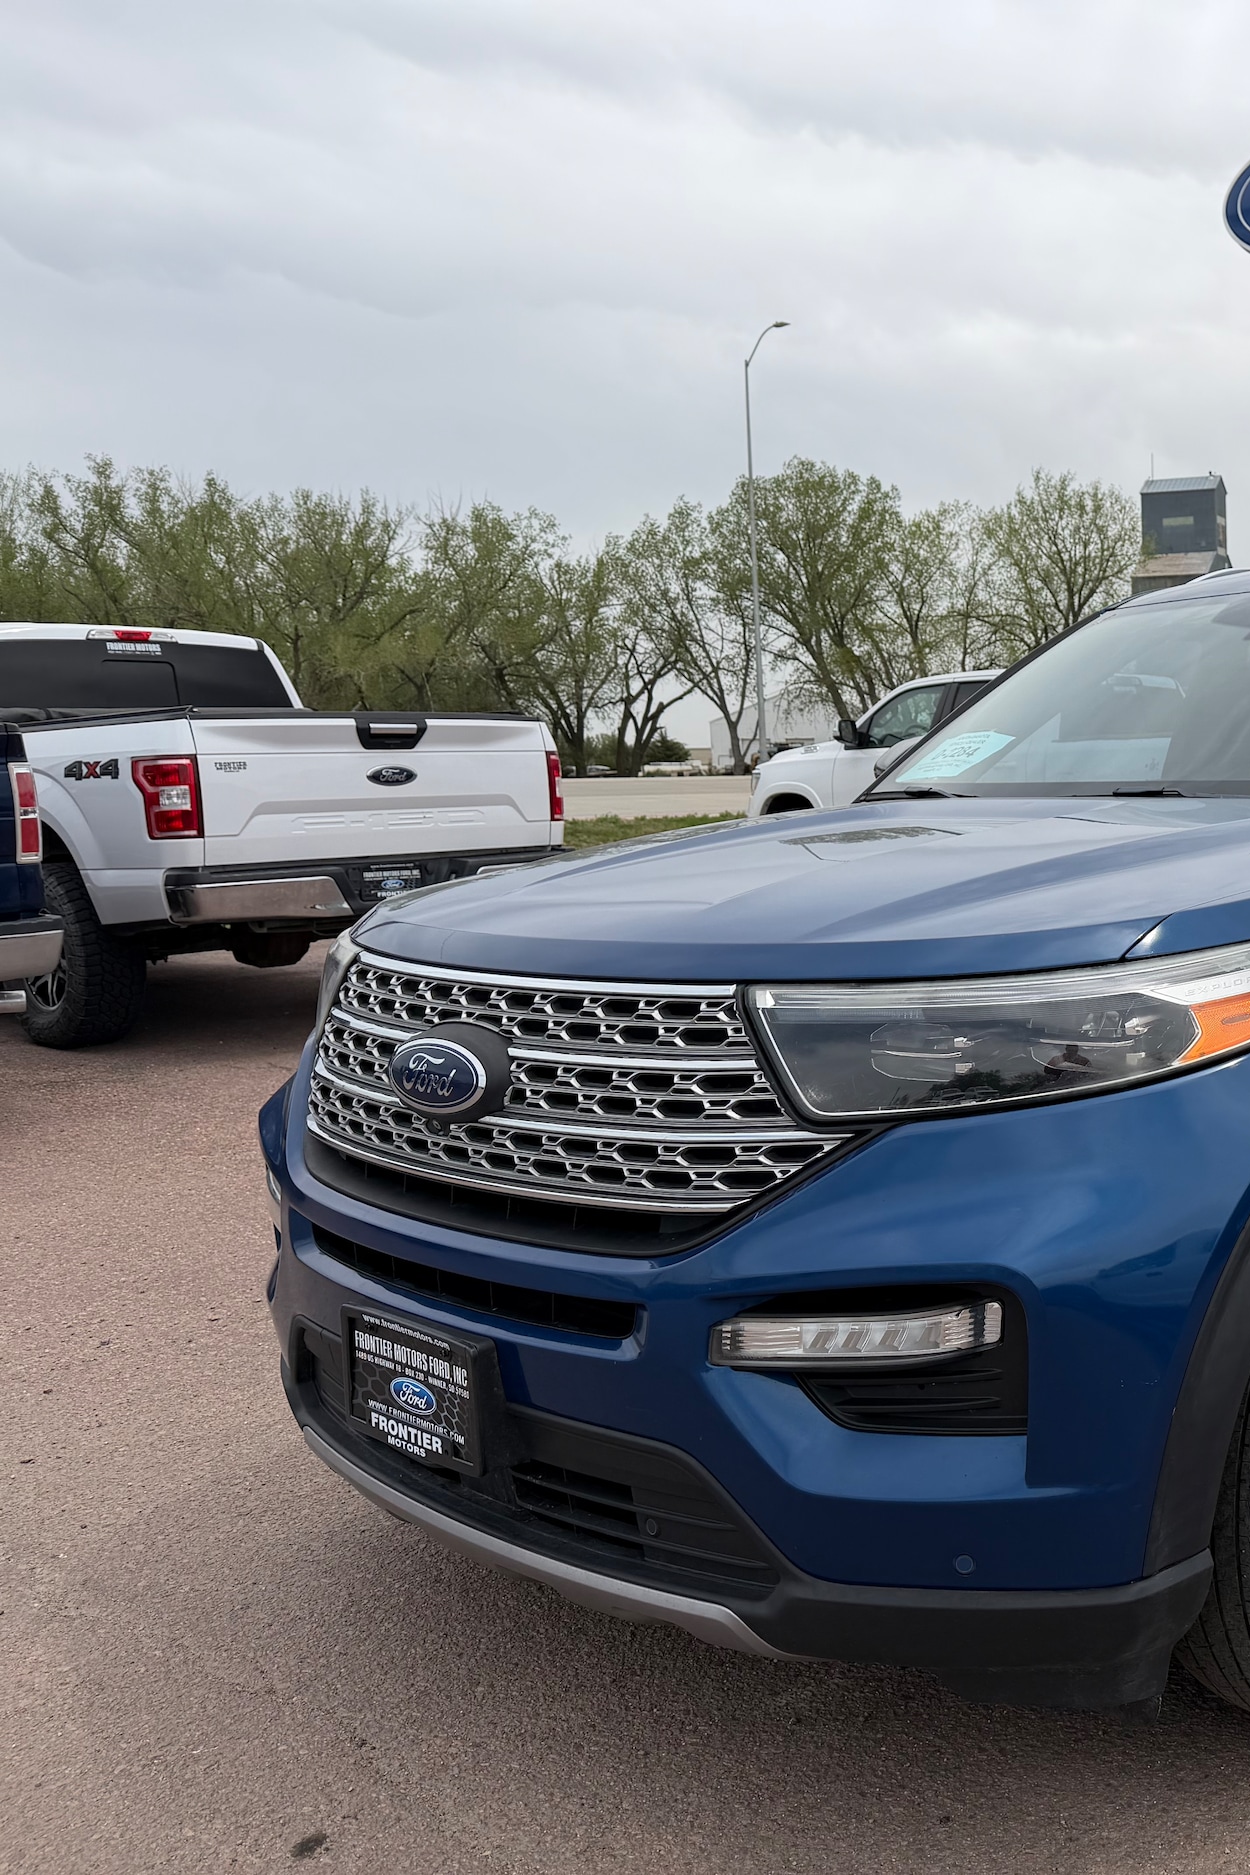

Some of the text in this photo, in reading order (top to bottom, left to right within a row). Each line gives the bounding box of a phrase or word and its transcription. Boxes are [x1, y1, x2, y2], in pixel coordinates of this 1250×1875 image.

[106, 642, 162, 652] FRONTIER MOTORS
[379, 768, 407, 781] Ford
[290, 809, 487, 834] F-150
[402, 1052, 457, 1097] Ford
[362, 1314, 450, 1350] www.frontiermotors.com
[354, 1330, 468, 1387] FRONTIER MOTORS FORD, INC
[367, 1353, 374, 1363] US
[399, 1382, 428, 1410] Ford
[368, 1399, 465, 1445] WWWFRONTIERMOTORSCOM
[370, 1411, 443, 1455] FRONTIER
[387, 1435, 426, 1458] MOTORS
